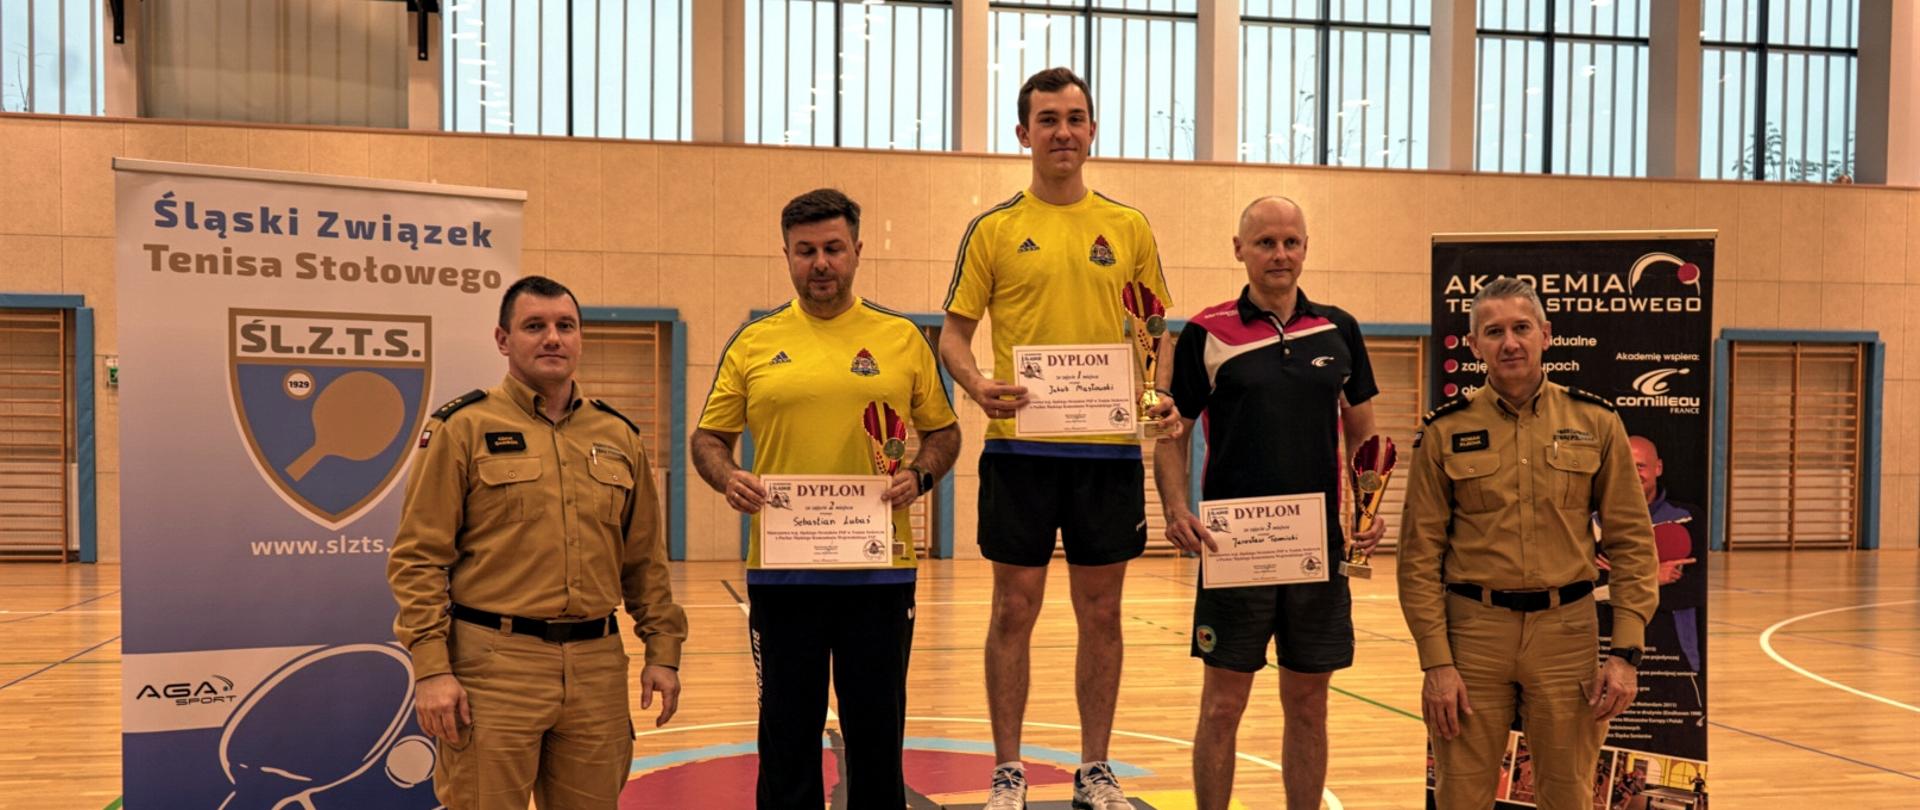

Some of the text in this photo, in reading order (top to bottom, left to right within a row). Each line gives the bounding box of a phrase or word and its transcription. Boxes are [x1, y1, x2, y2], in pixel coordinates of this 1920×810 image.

[154, 191, 492, 250] Śląski Związek
[143, 243, 502, 294] Tenisa Stołowego
[1444, 274, 1625, 294] AKDEMIA
[1546, 297, 1702, 312] STOŁOWEGO
[240, 320, 421, 358] ŚL.Z.T.S.
[1550, 335, 1598, 347] idualne
[1047, 354, 1109, 367] DYPLOM
[1616, 352, 1700, 362] Akademię wspiera:
[1461, 361, 1488, 374] zaję
[288, 380, 310, 389] 1929
[1616, 396, 1700, 407] cornilleau
[797, 484, 865, 497] DYPLOM
[1234, 504, 1300, 520] DYPLOM
[251, 535, 391, 556] www.slzts.
[136, 681, 218, 700] AGA
[175, 695, 237, 706] SPORT
